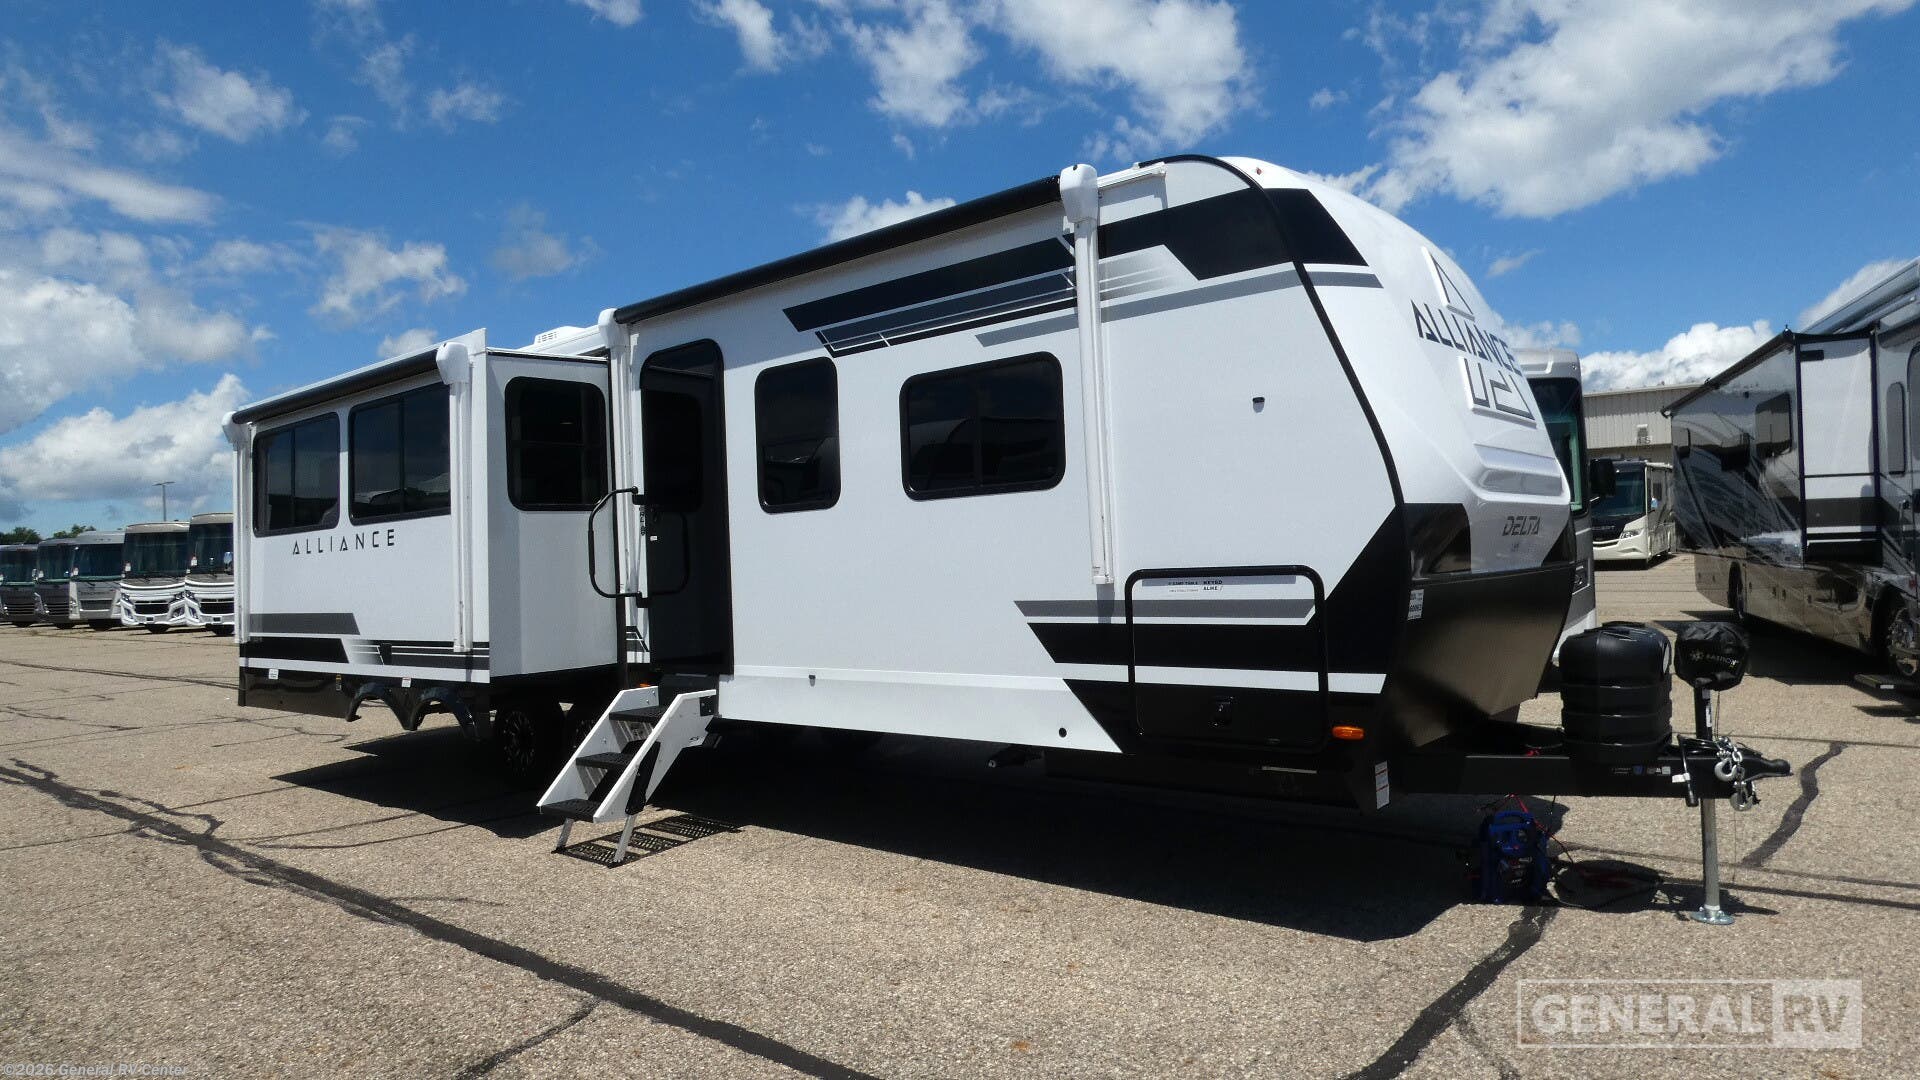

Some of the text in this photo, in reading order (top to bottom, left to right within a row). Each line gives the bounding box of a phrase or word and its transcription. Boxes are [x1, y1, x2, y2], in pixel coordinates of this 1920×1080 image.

[1410, 299, 1522, 377] ALLIANCE
[1502, 515, 1541, 537] DELTA
[292, 528, 395, 556] ALLIANCE
